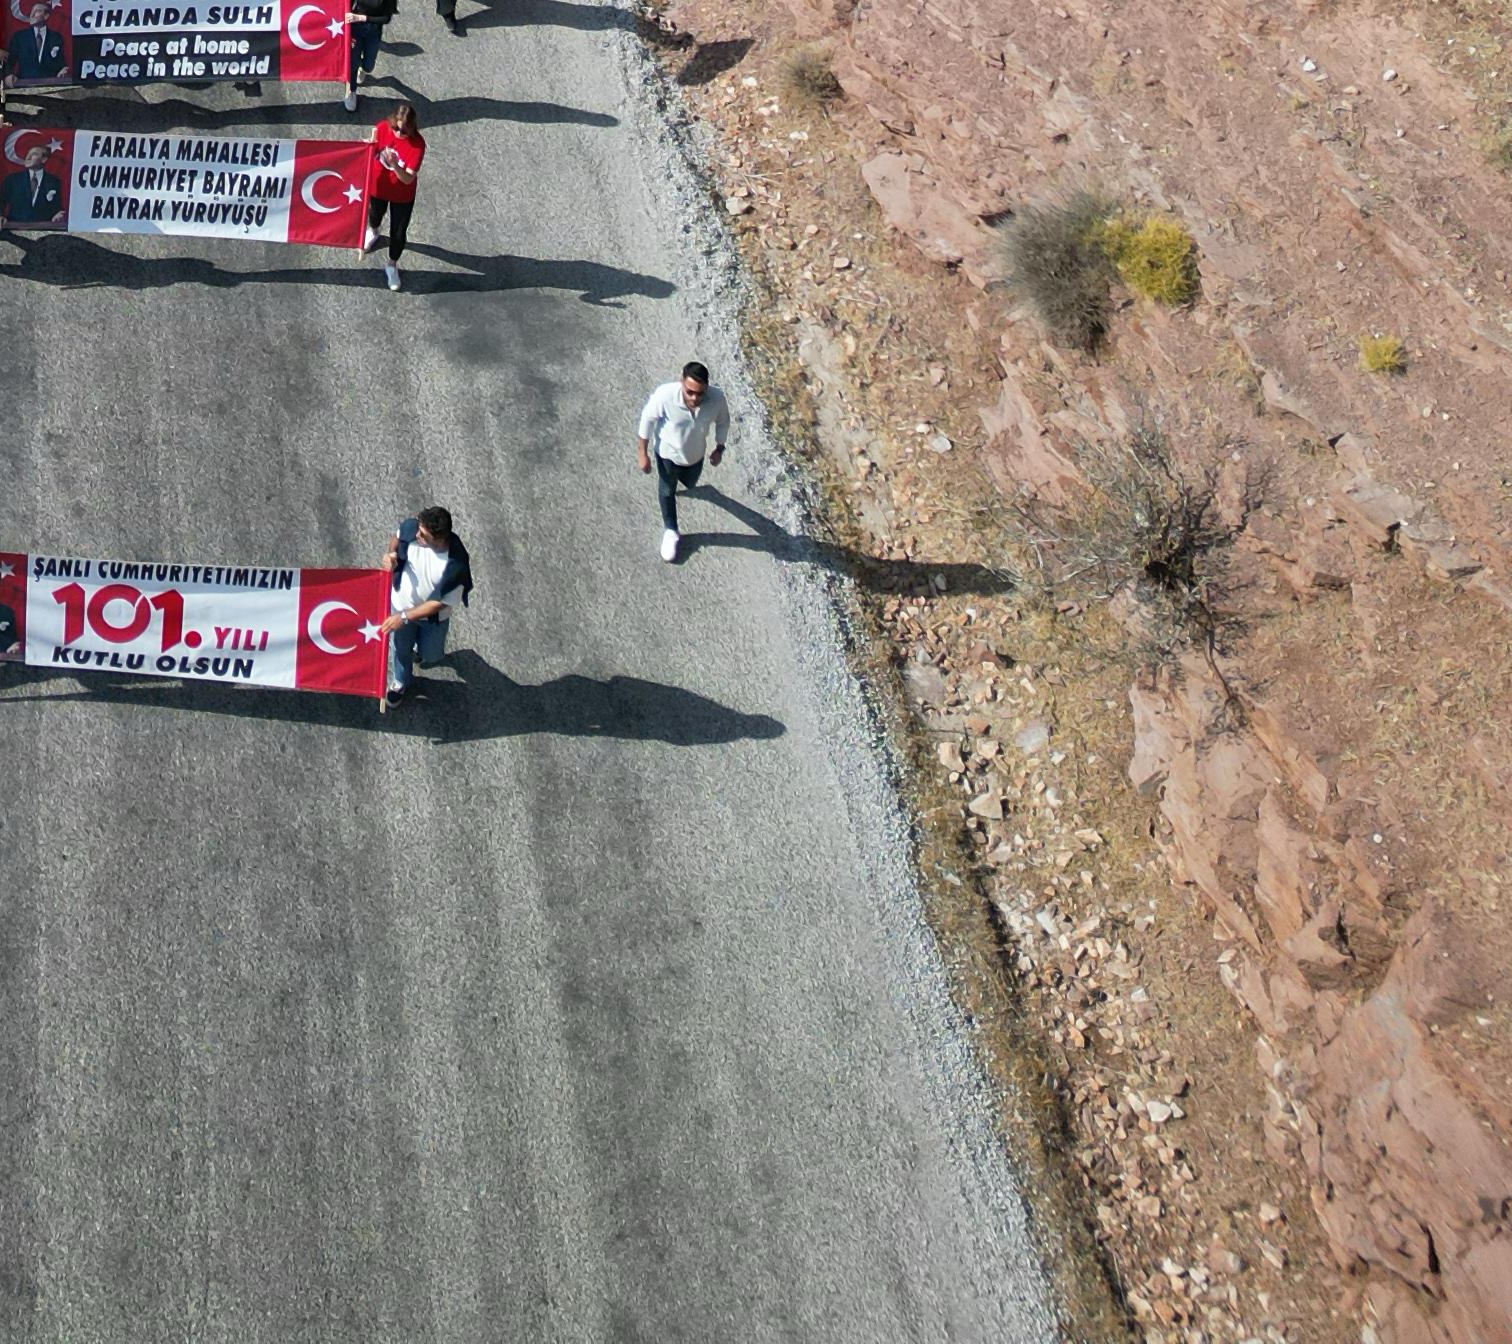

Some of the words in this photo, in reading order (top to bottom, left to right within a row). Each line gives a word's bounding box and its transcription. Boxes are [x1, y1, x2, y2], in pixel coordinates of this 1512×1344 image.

[79, 3, 198, 29] CİHANDA
[206, 6, 273, 26] SULH
[100, 38, 159, 57] Peace
[166, 37, 187, 54] at
[194, 35, 250, 55] home
[80, 59, 140, 79] Peace
[146, 57, 166, 77] in
[172, 57, 206, 76] the
[211, 55, 270, 76] world
[90, 135, 171, 160] FARALYA
[175, 140, 280, 167] MAHALLESİ
[78, 162, 198, 193] CUMHURİYET
[202, 170, 288, 199] BAYRAMI
[91, 195, 166, 221] BAYRAK
[171, 194, 268, 233] YÜRÜYÜŞÜ
[33, 556, 91, 582] ŞANLI
[52, 582, 202, 653] 101.
[214, 626, 270, 652] YILI
[51, 645, 145, 670] KUTLU
[155, 654, 255, 679] OLSUN
